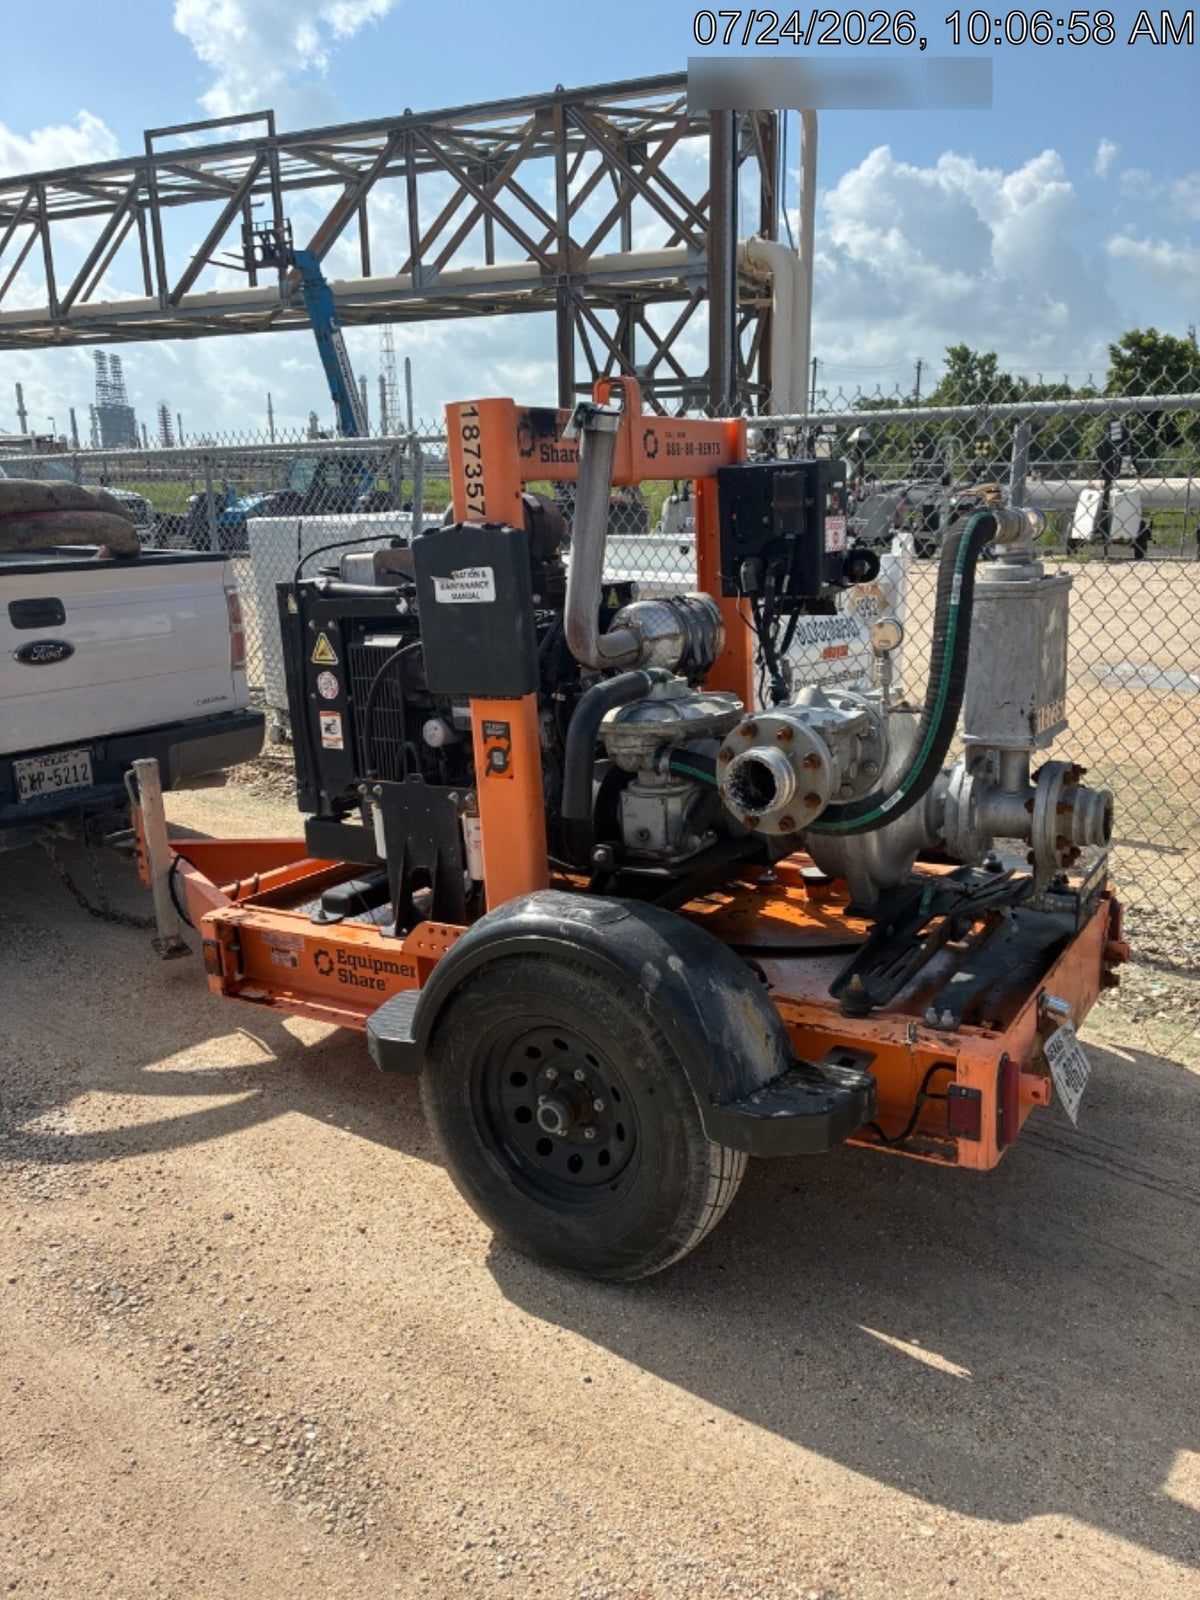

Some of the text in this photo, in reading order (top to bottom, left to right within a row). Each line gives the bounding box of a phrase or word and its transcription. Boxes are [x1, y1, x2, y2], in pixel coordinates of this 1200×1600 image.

[460, 404, 486, 516] 187357
[451, 591, 481, 600] MANUAL
[31, 644, 63, 661] Ford
[38, 752, 69, 768] TEXAS
[338, 967, 387, 991] Share
